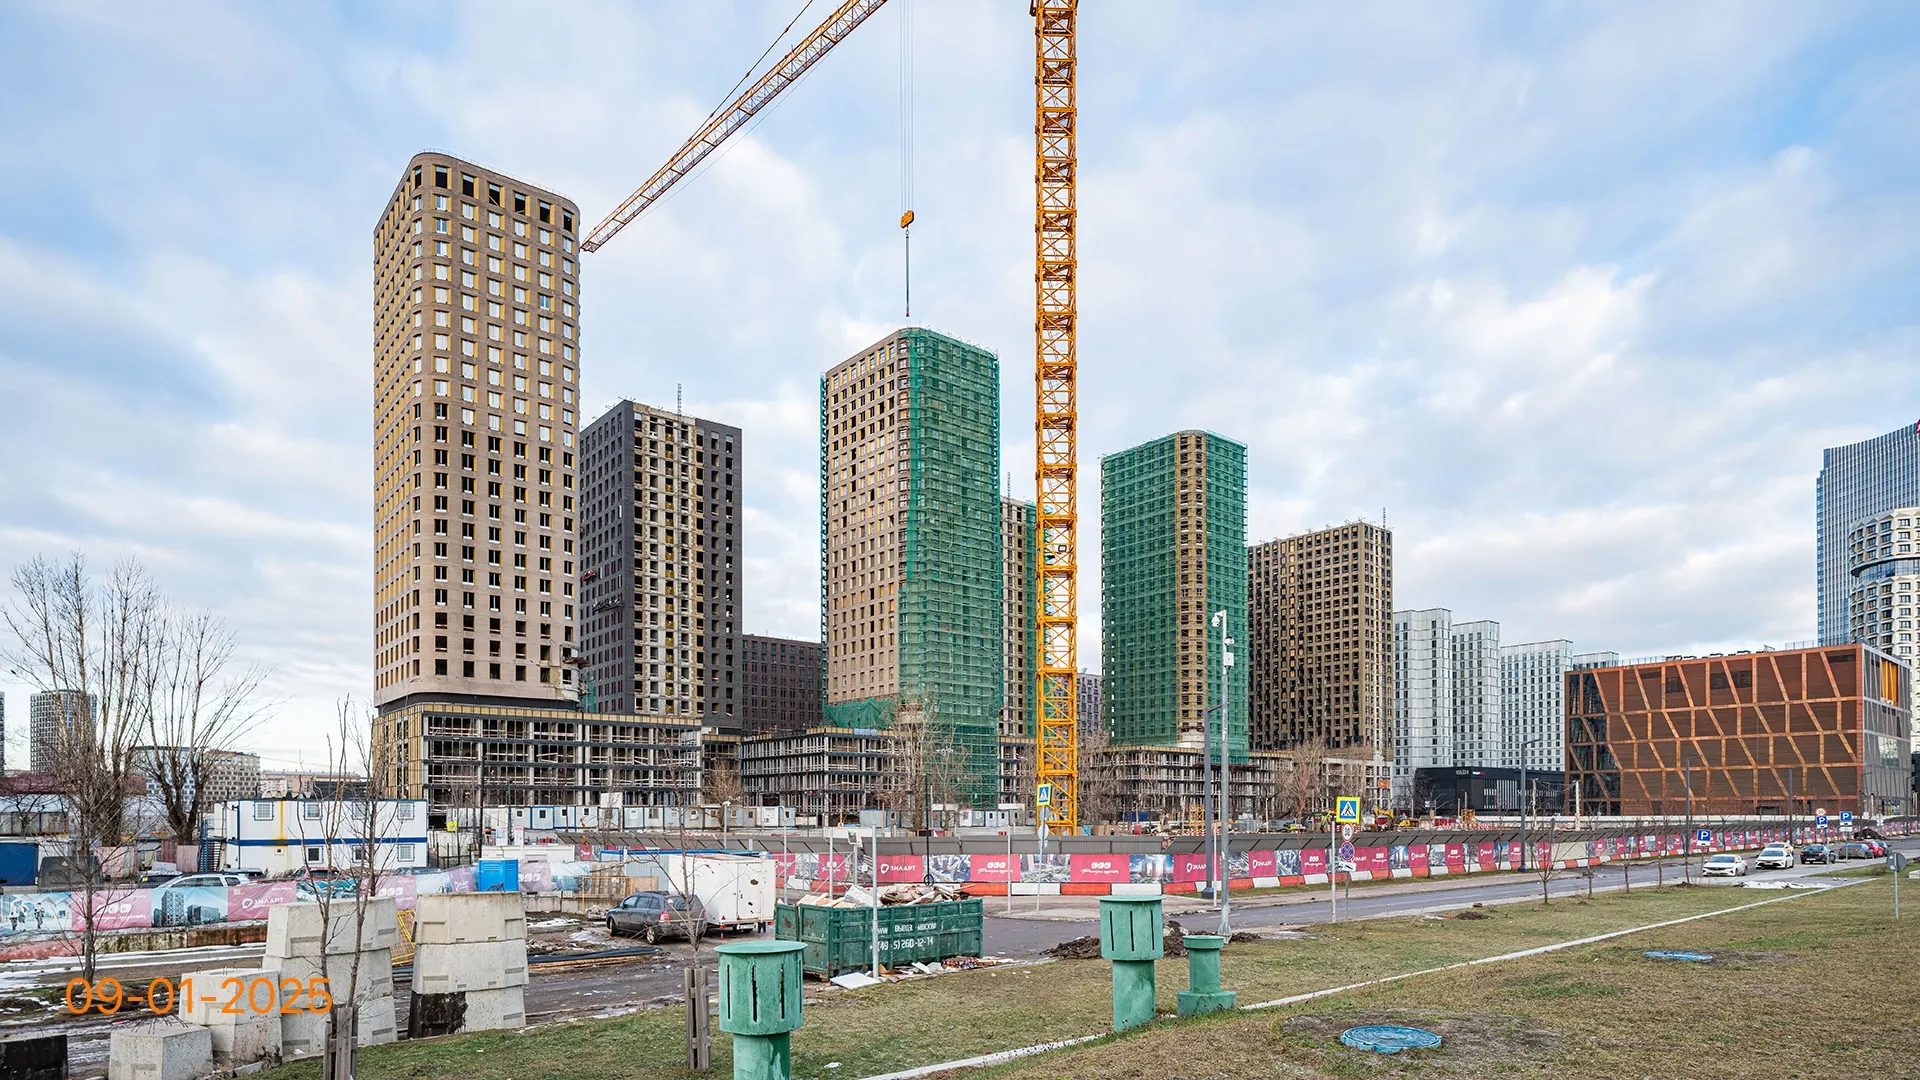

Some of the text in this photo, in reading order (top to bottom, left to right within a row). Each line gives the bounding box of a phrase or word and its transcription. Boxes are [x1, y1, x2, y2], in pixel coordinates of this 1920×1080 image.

[1819, 816, 1826, 824] P
[1842, 812, 1850, 820] P
[1700, 831, 1709, 840] P
[254, 897, 284, 906] ЗИЛАРТ
